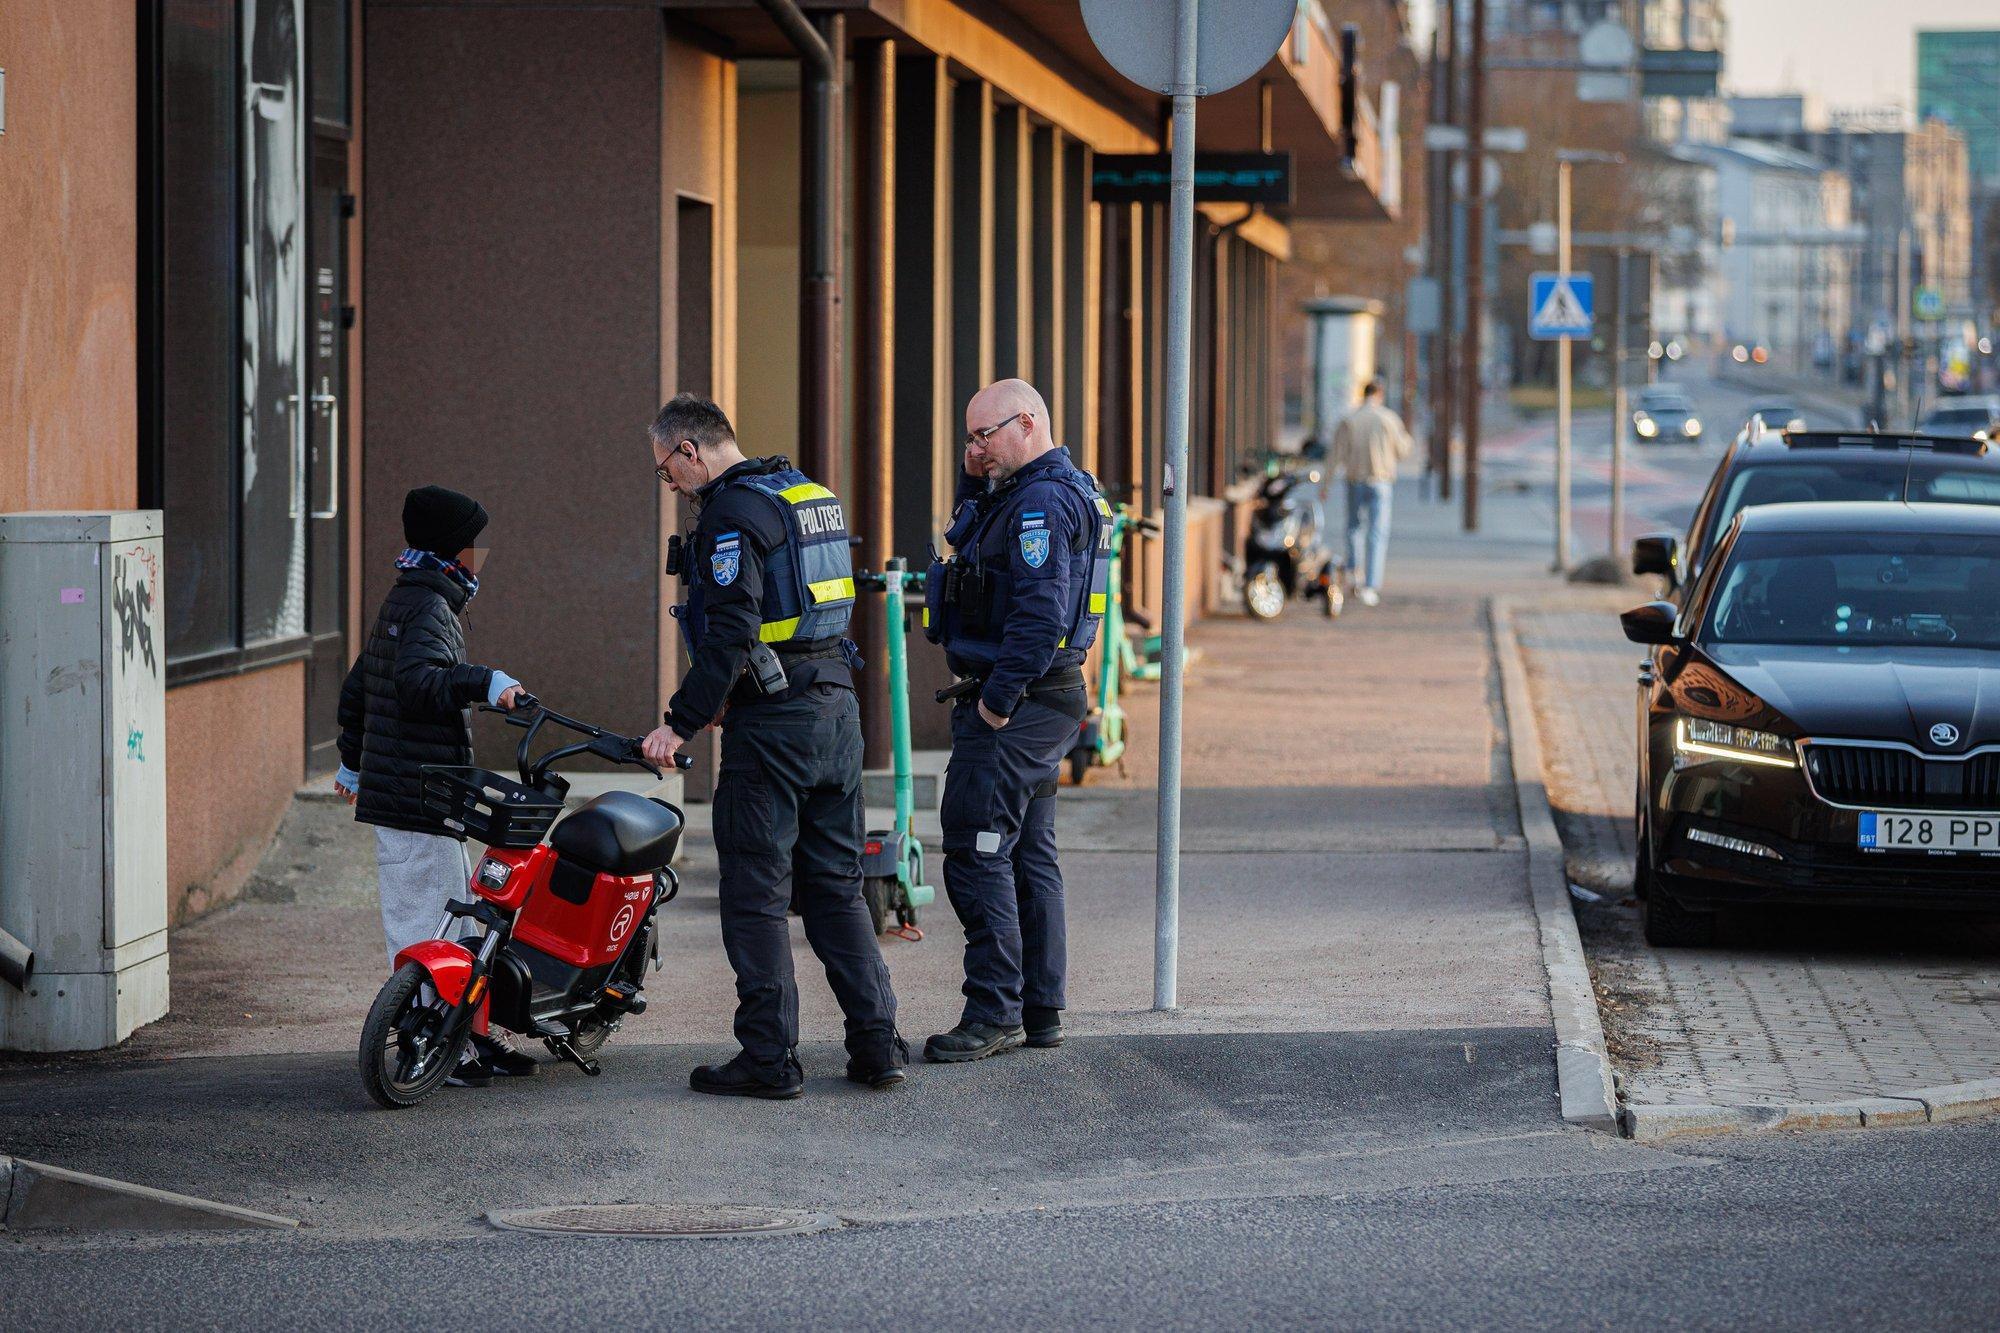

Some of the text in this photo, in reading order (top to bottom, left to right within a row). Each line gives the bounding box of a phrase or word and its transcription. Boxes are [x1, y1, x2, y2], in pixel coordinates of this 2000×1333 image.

[797, 505, 845, 535] POLITSEI
[1022, 530, 1047, 540] POLITSEI
[1884, 817, 2000, 847] 128 PP
[1860, 834, 1876, 843] EST
[606, 943, 619, 952] RIDE
